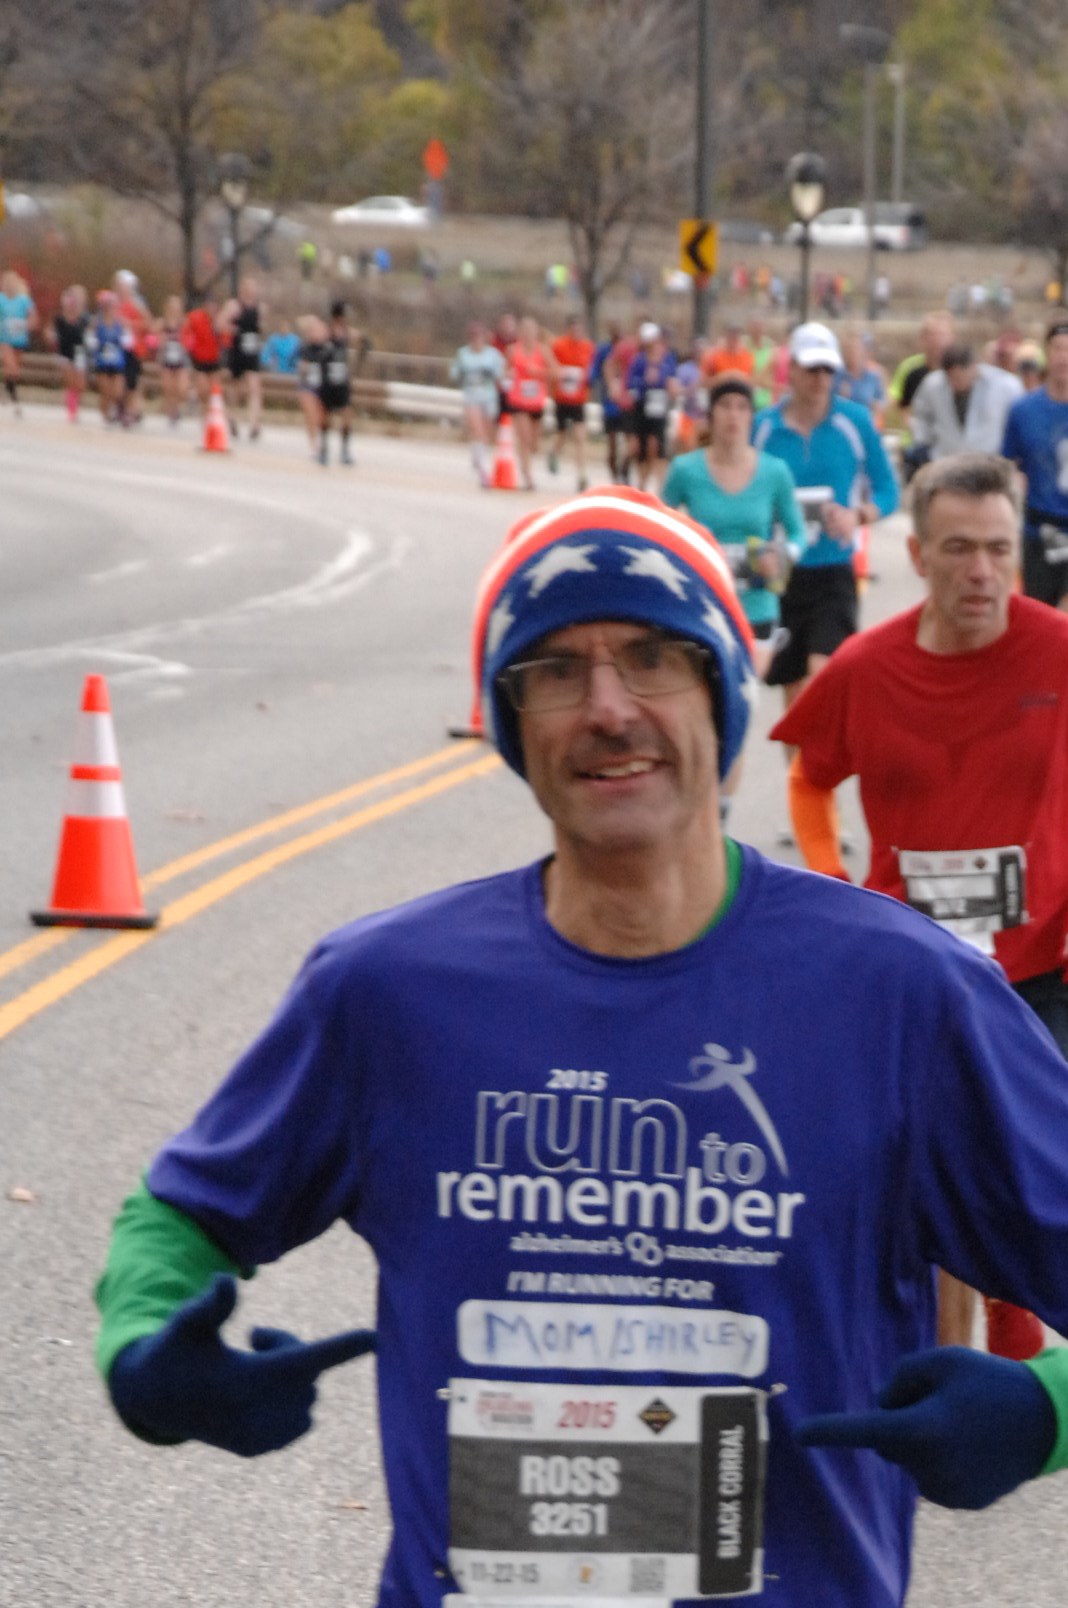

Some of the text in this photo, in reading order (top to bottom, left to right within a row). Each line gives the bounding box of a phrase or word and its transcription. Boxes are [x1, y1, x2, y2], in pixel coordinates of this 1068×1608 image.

[545, 1068, 609, 1091] 2015
[475, 1090, 767, 1185] run to
[437, 1167, 805, 1239] remember
[507, 1270, 715, 1301] I'M RUNNING FOR
[556, 1401, 618, 1429] 2015
[519, 1455, 622, 1497] ROSS
[717, 1424, 745, 1559] BLACK CORRAL
[529, 1501, 609, 1536] 3251
